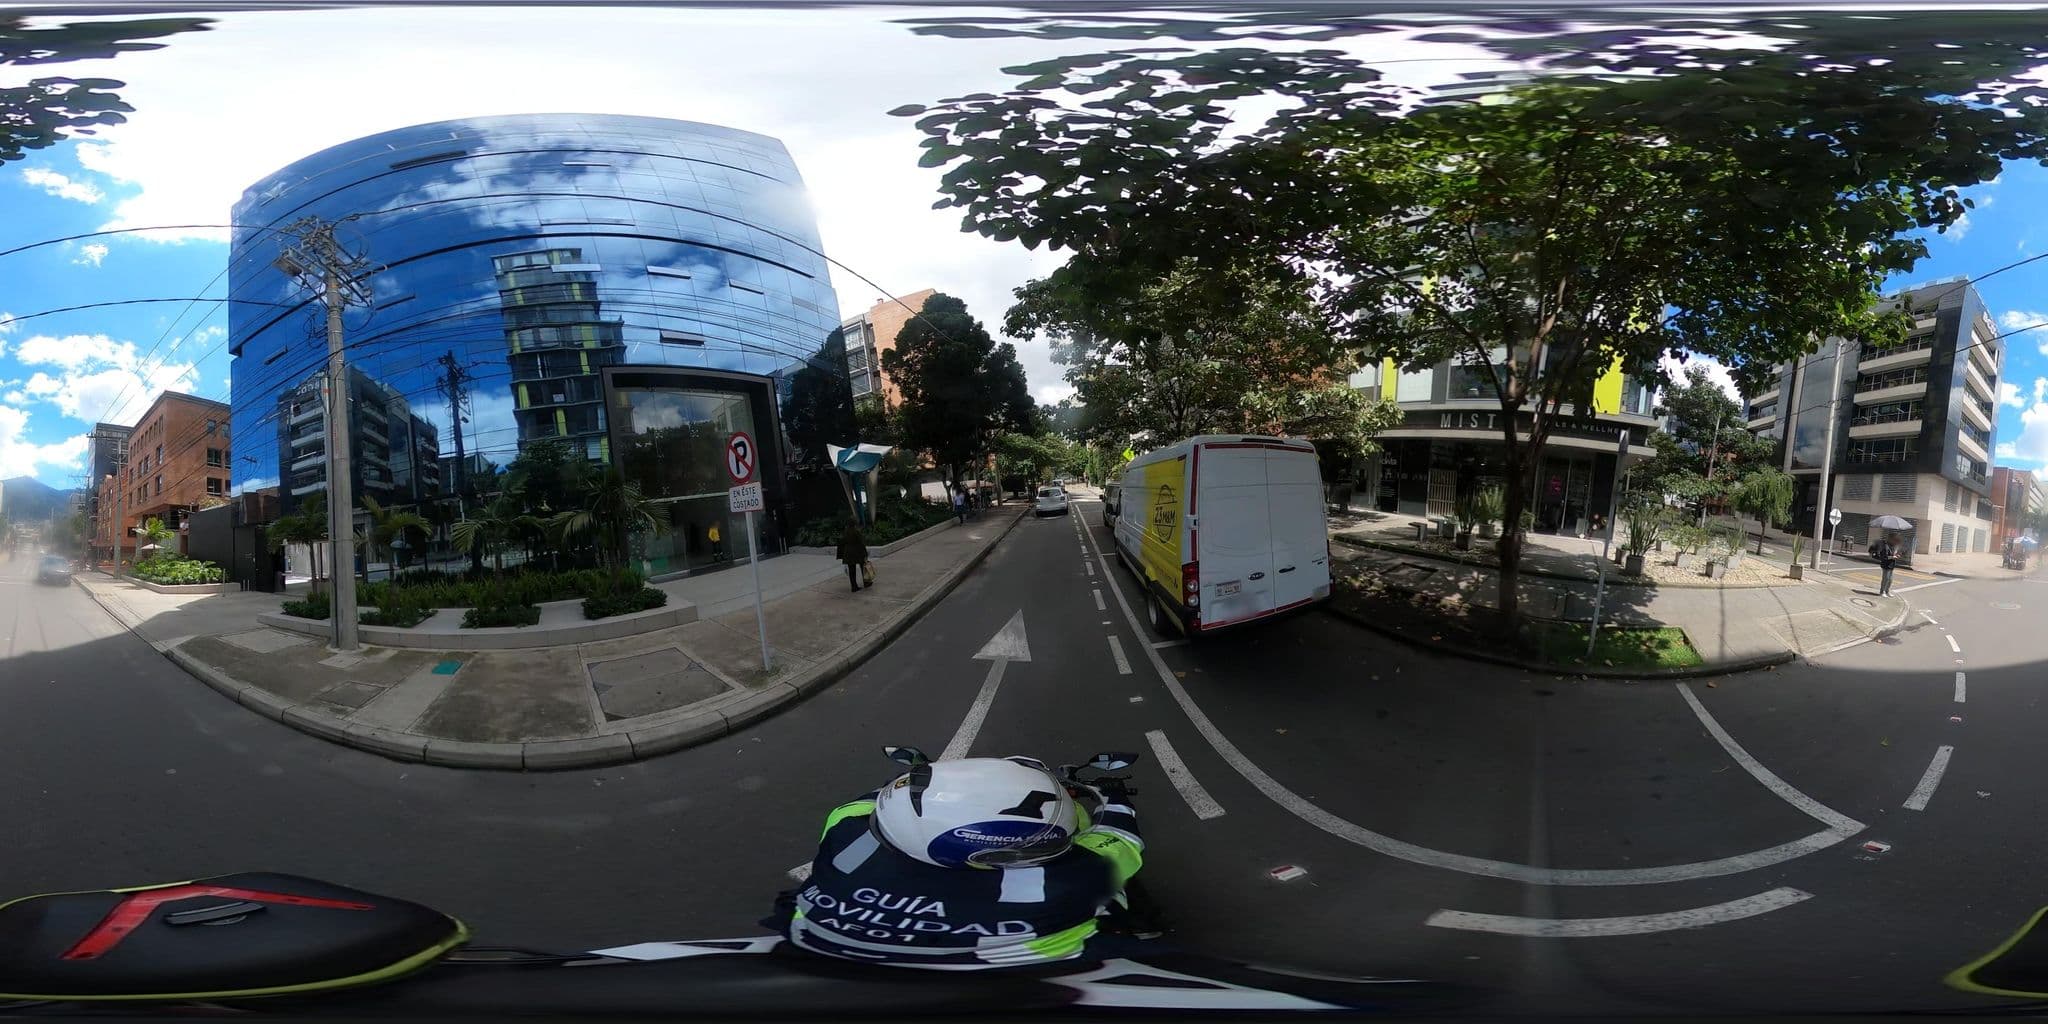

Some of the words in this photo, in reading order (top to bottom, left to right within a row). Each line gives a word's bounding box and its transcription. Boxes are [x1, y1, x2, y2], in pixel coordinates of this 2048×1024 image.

[1440, 413, 1496, 429] MIST
[1582, 422, 1620, 434] WELLNE
[733, 498, 759, 510] COSTADO
[953, 828, 1023, 842] GERENCIA
[852, 887, 947, 917] GUÍA
[803, 885, 1035, 936] MOVILIDAD
